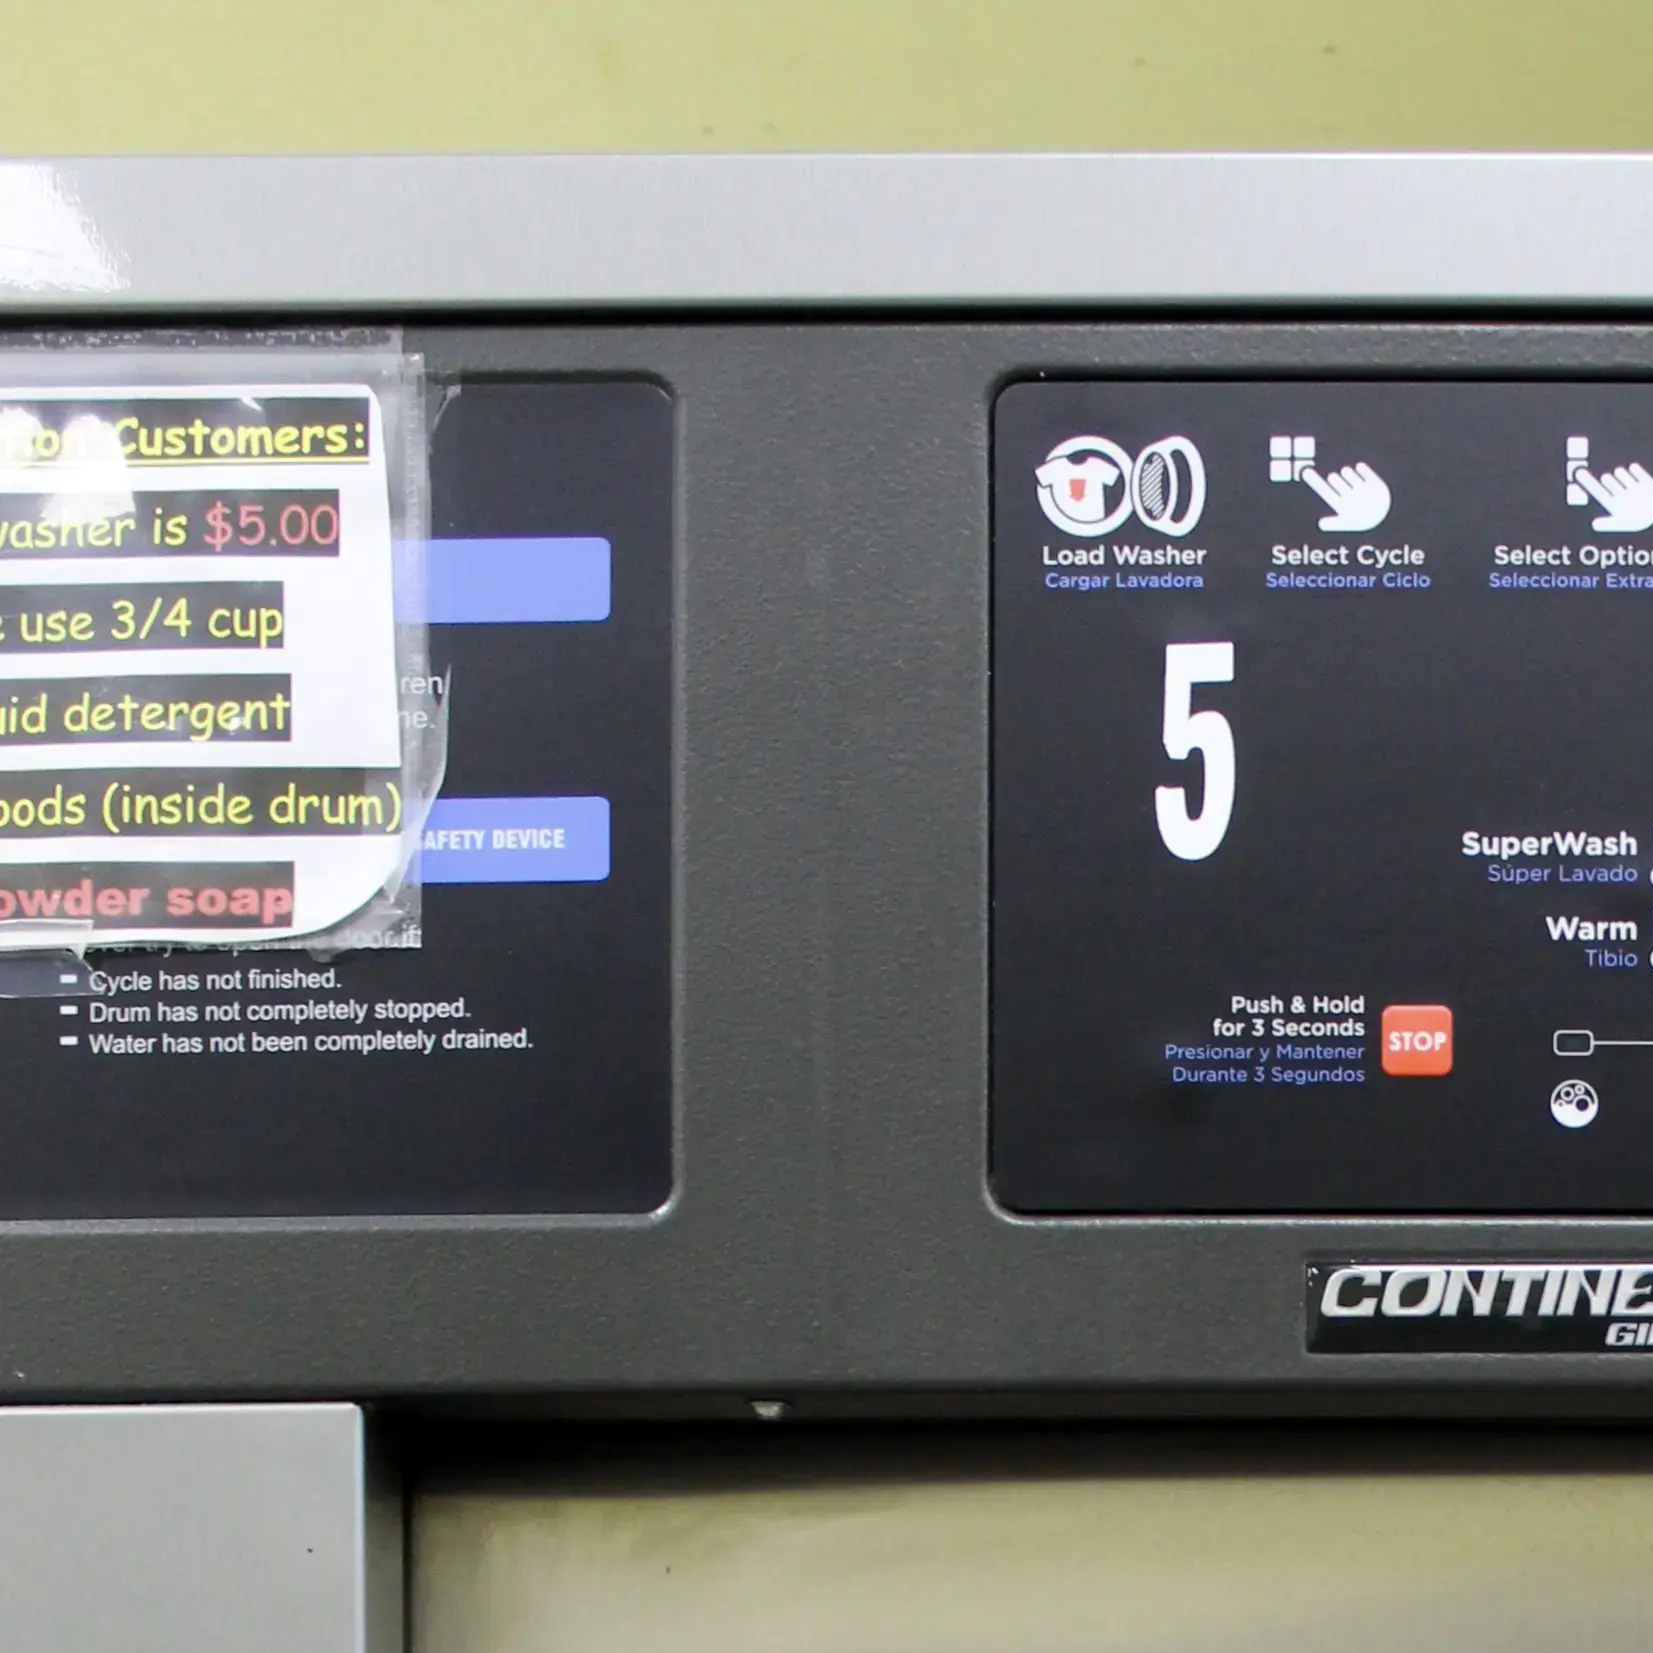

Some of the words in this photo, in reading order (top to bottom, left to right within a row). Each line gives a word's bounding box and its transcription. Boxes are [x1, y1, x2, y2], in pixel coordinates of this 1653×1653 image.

[114, 417, 365, 456] Customers:
[153, 507, 188, 545] is
[204, 501, 340, 552] $5.00
[1044, 545, 1104, 565] Load
[1113, 545, 1207, 565] Washer
[1272, 545, 1349, 565] Select
[1357, 545, 1424, 568] Cycle
[1495, 545, 1571, 565] Select
[1045, 573, 1110, 590] Cargar
[1116, 572, 1203, 587] Lavadora
[1267, 572, 1376, 587] Seleccionar
[1383, 572, 1430, 587] Ciclo
[1490, 572, 1599, 588] Seleccionar
[20, 610, 95, 642] use
[110, 598, 192, 641] 3/4
[208, 608, 284, 648] cup
[63, 692, 290, 743] detergent
[1155, 642, 1235, 860] 5
[102, 782, 253, 833] (inside
[269, 782, 401, 833] drum)
[418, 829, 486, 850] AFETY
[492, 828, 565, 849] DEVICE
[1463, 831, 1637, 860] SuperWash
[1489, 864, 1551, 884] Súper
[1560, 864, 1638, 881] Lavado
[0, 878, 150, 918] owder
[166, 885, 294, 924] soap
[1546, 917, 1637, 940] Warm
[1585, 949, 1637, 966] Tibio
[87, 966, 152, 993] Cycle
[159, 971, 199, 990] has
[207, 971, 242, 989] not
[248, 968, 341, 989] finished.
[90, 1002, 150, 1022] Drum
[158, 1002, 198, 1021] has
[205, 1002, 240, 1021] not
[247, 999, 368, 1024] completely
[375, 998, 470, 1023] stopped.
[1232, 996, 1283, 1013] Push
[1291, 996, 1305, 1013] &
[1314, 996, 1364, 1013] Hold
[1213, 1018, 1245, 1036] for
[1252, 1019, 1264, 1036] 3
[1272, 1018, 1365, 1036] Seconds
[89, 1034, 157, 1053] Water
[163, 1033, 203, 1053] has
[210, 1033, 245, 1052] not
[252, 1032, 307, 1052] been
[315, 1029, 436, 1055] completely
[442, 1028, 532, 1049] drained.
[1390, 1031, 1446, 1051] STOP
[1166, 1044, 1253, 1059] Presionar
[1260, 1048, 1269, 1062] y
[1277, 1044, 1365, 1059] Mantener
[1173, 1067, 1247, 1082] Durante
[1254, 1067, 1264, 1082] 3
[1272, 1067, 1364, 1084] Segundos
